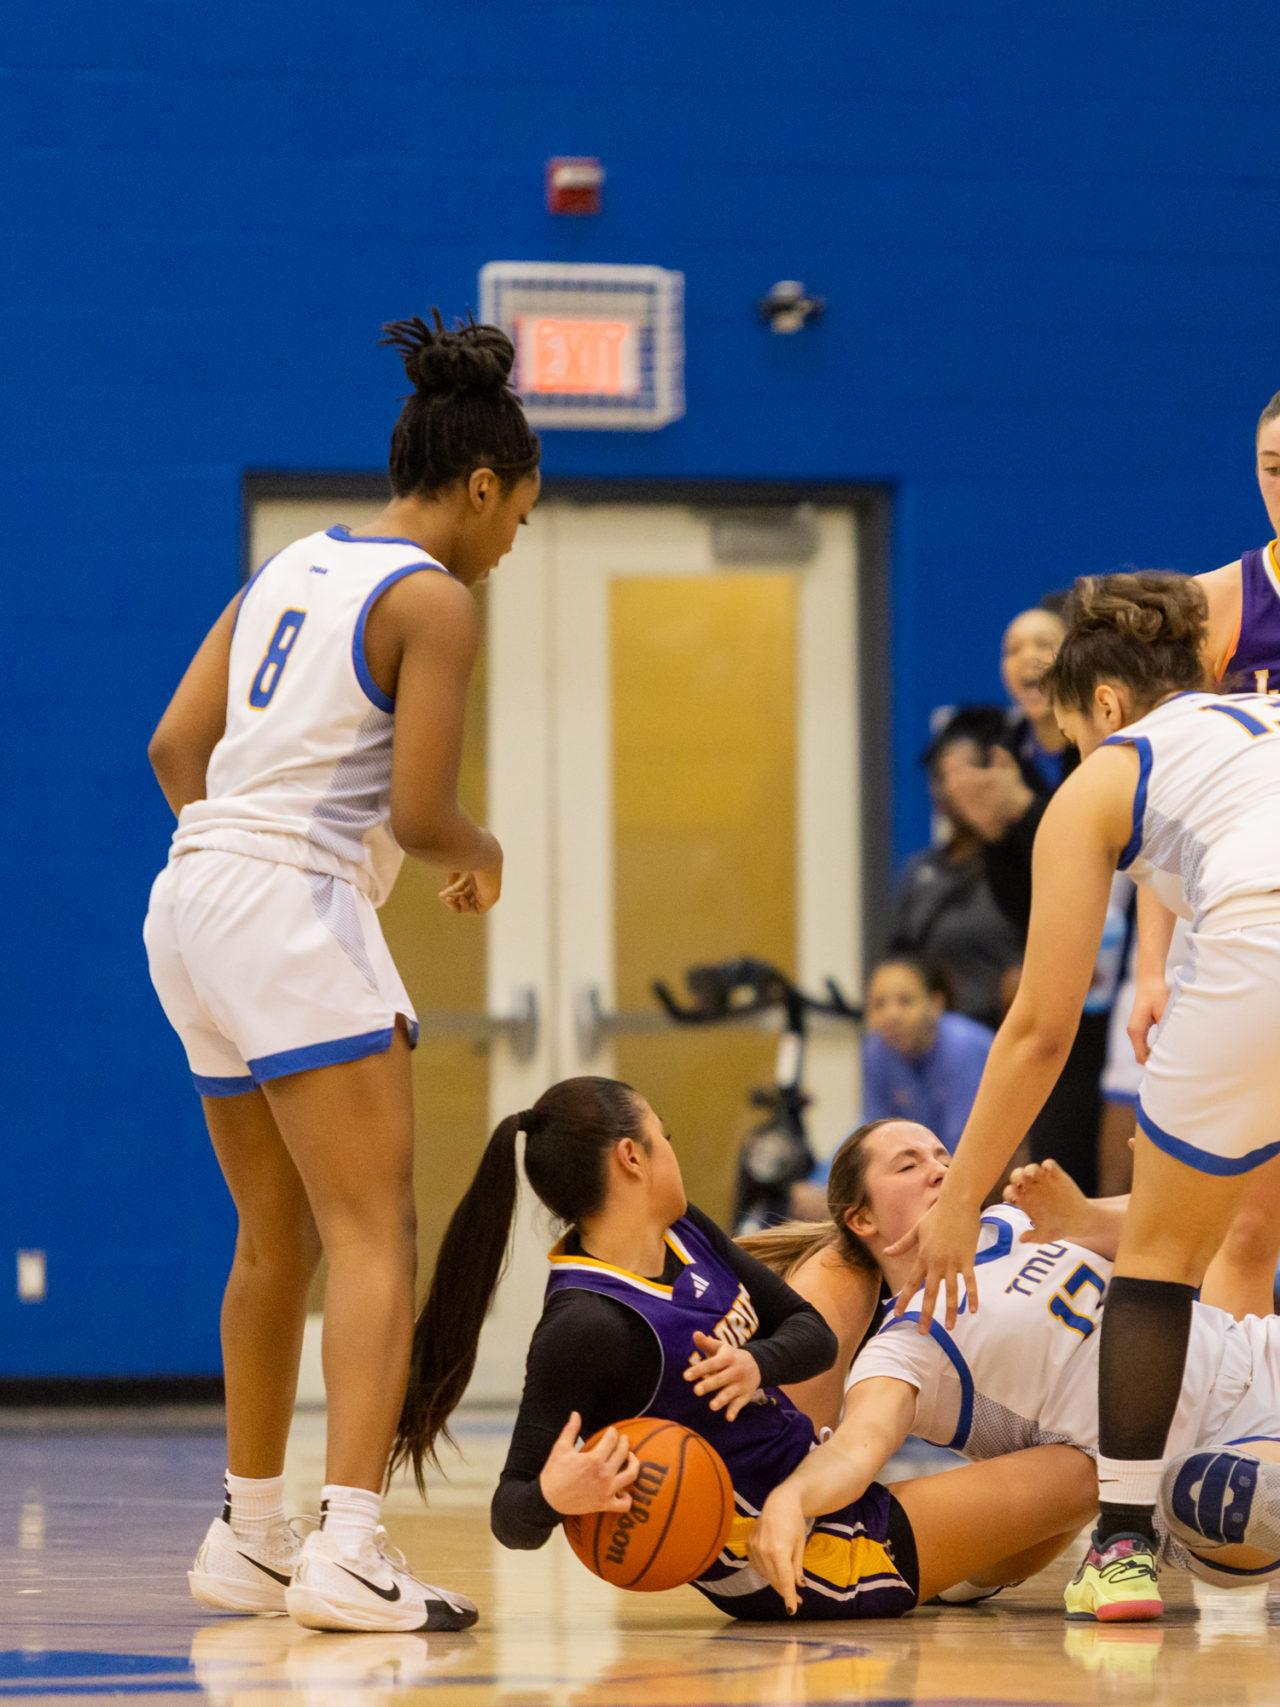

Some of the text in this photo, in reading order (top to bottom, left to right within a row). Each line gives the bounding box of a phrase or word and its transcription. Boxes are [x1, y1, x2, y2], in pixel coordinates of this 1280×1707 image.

[534, 320, 629, 393] EXIT
[248, 606, 308, 711] 8
[1004, 1241, 1069, 1297] TMU
[605, 1461, 669, 1565] Wilson
